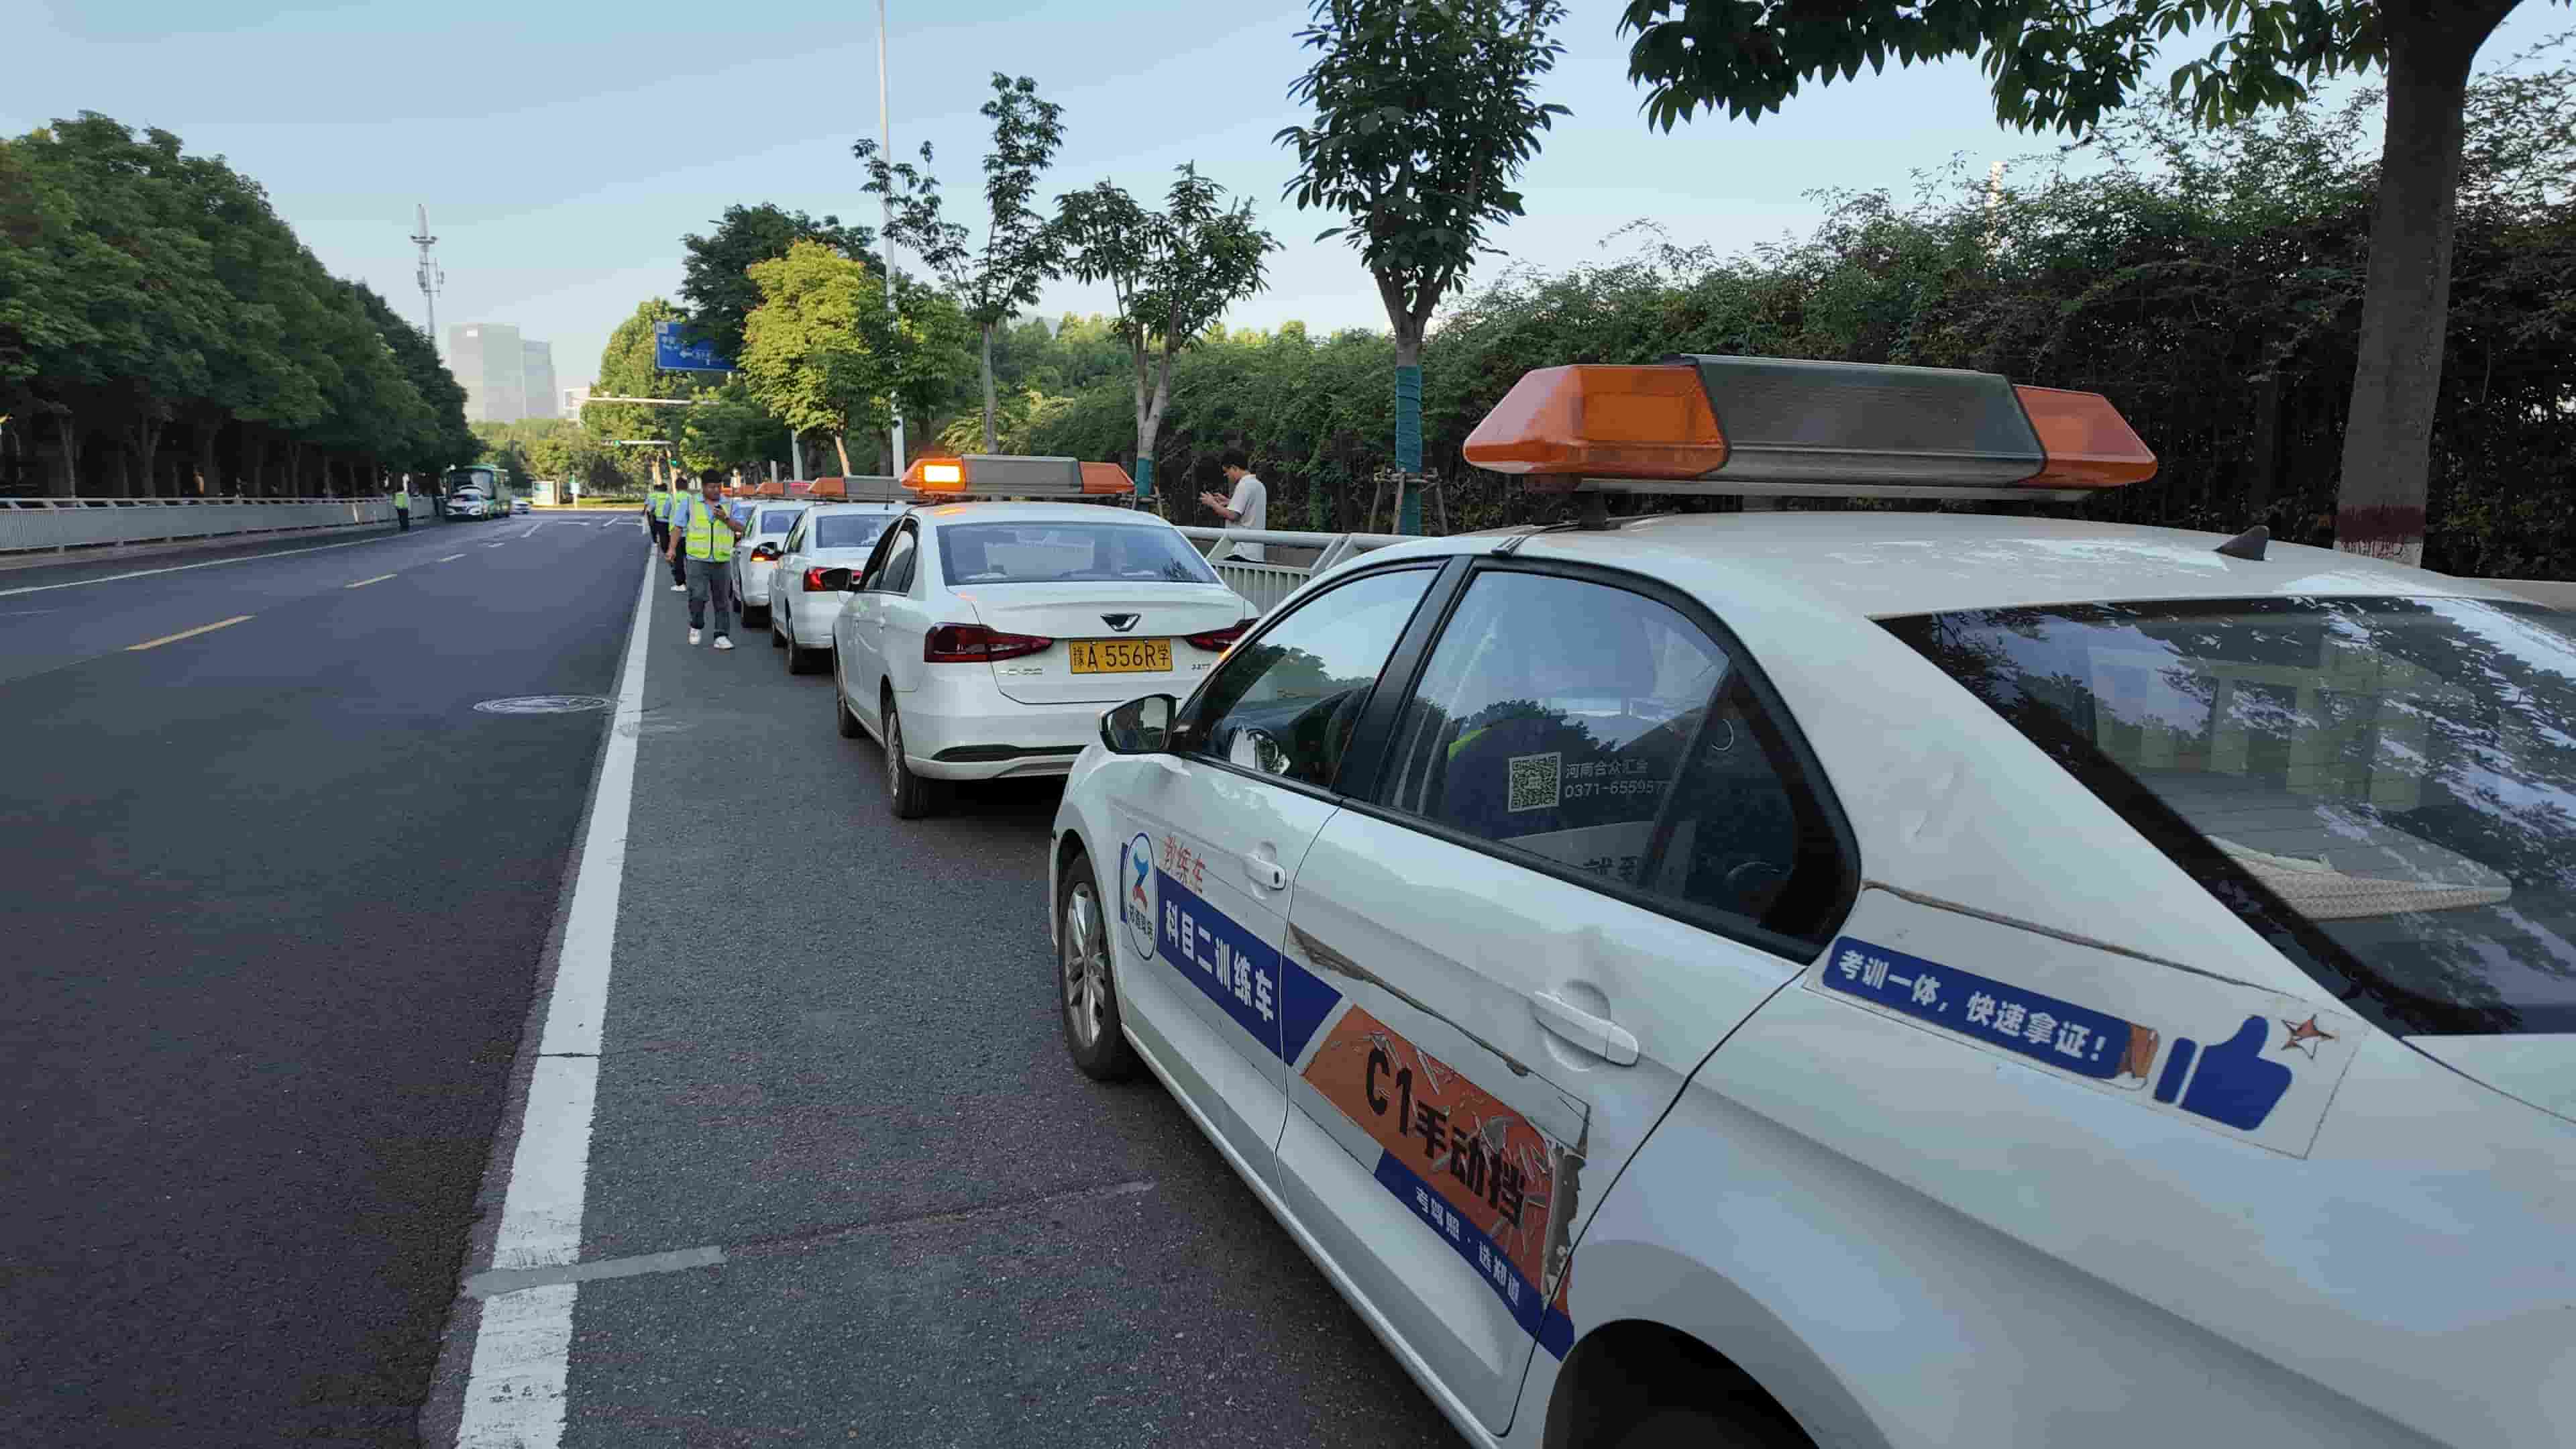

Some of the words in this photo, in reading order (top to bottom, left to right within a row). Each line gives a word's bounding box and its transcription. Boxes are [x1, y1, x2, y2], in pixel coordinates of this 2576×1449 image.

[1165, 900, 1274, 1022] 科目二训练车
